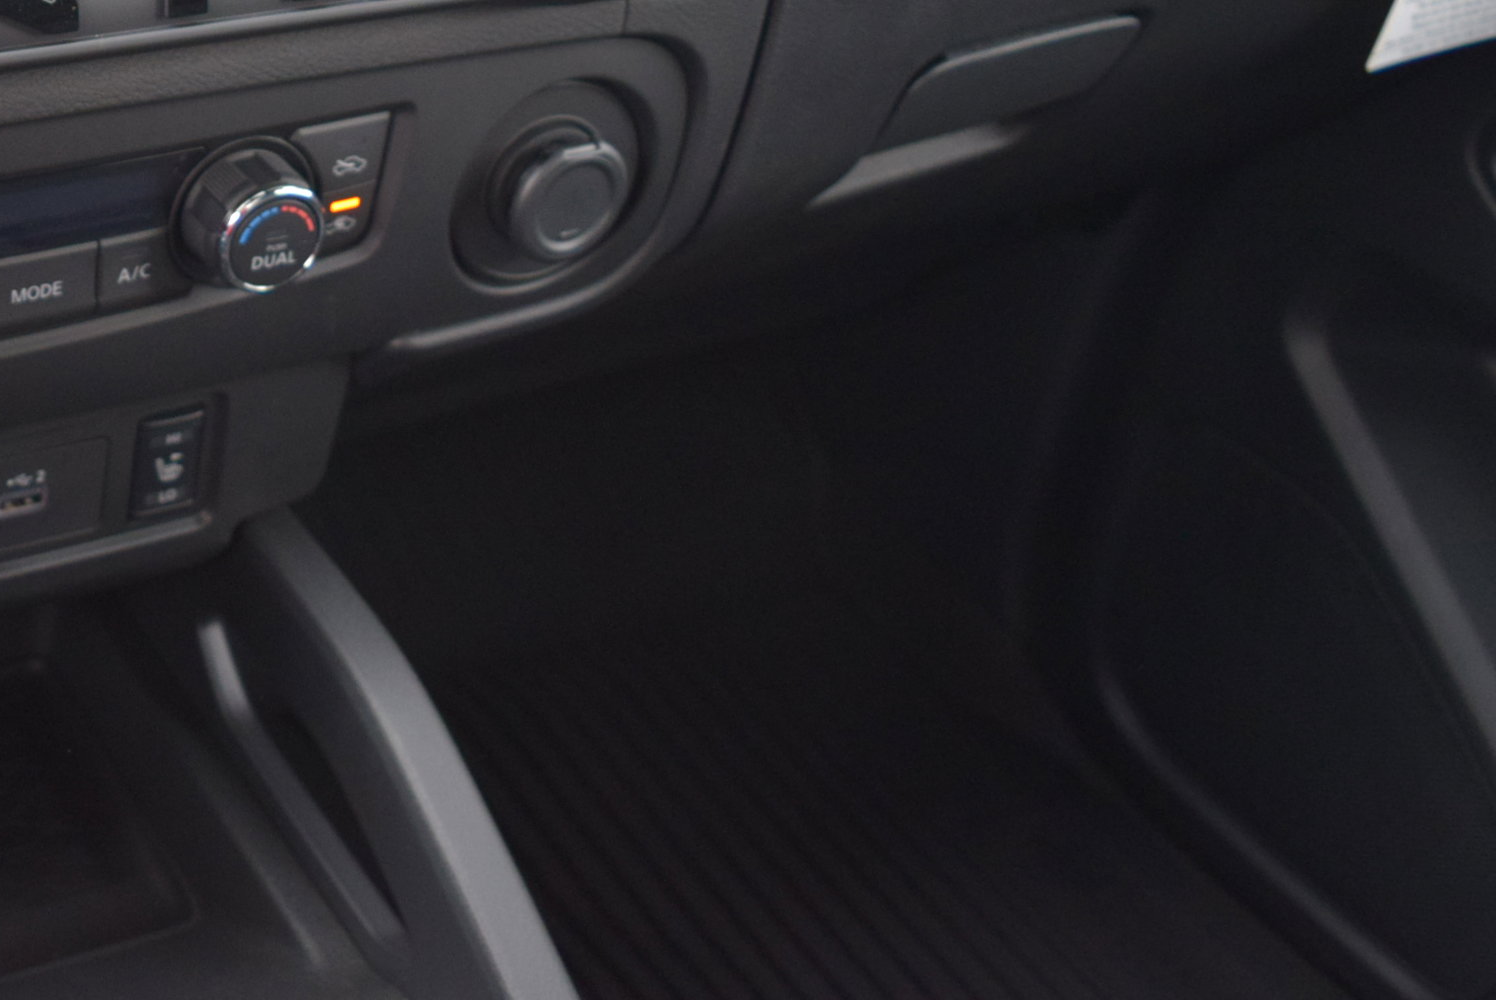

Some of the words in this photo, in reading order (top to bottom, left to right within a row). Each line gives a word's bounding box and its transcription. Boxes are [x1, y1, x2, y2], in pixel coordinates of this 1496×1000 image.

[250, 250, 297, 271] DUAL
[117, 262, 153, 285] A/C
[10, 280, 64, 304] MODE
